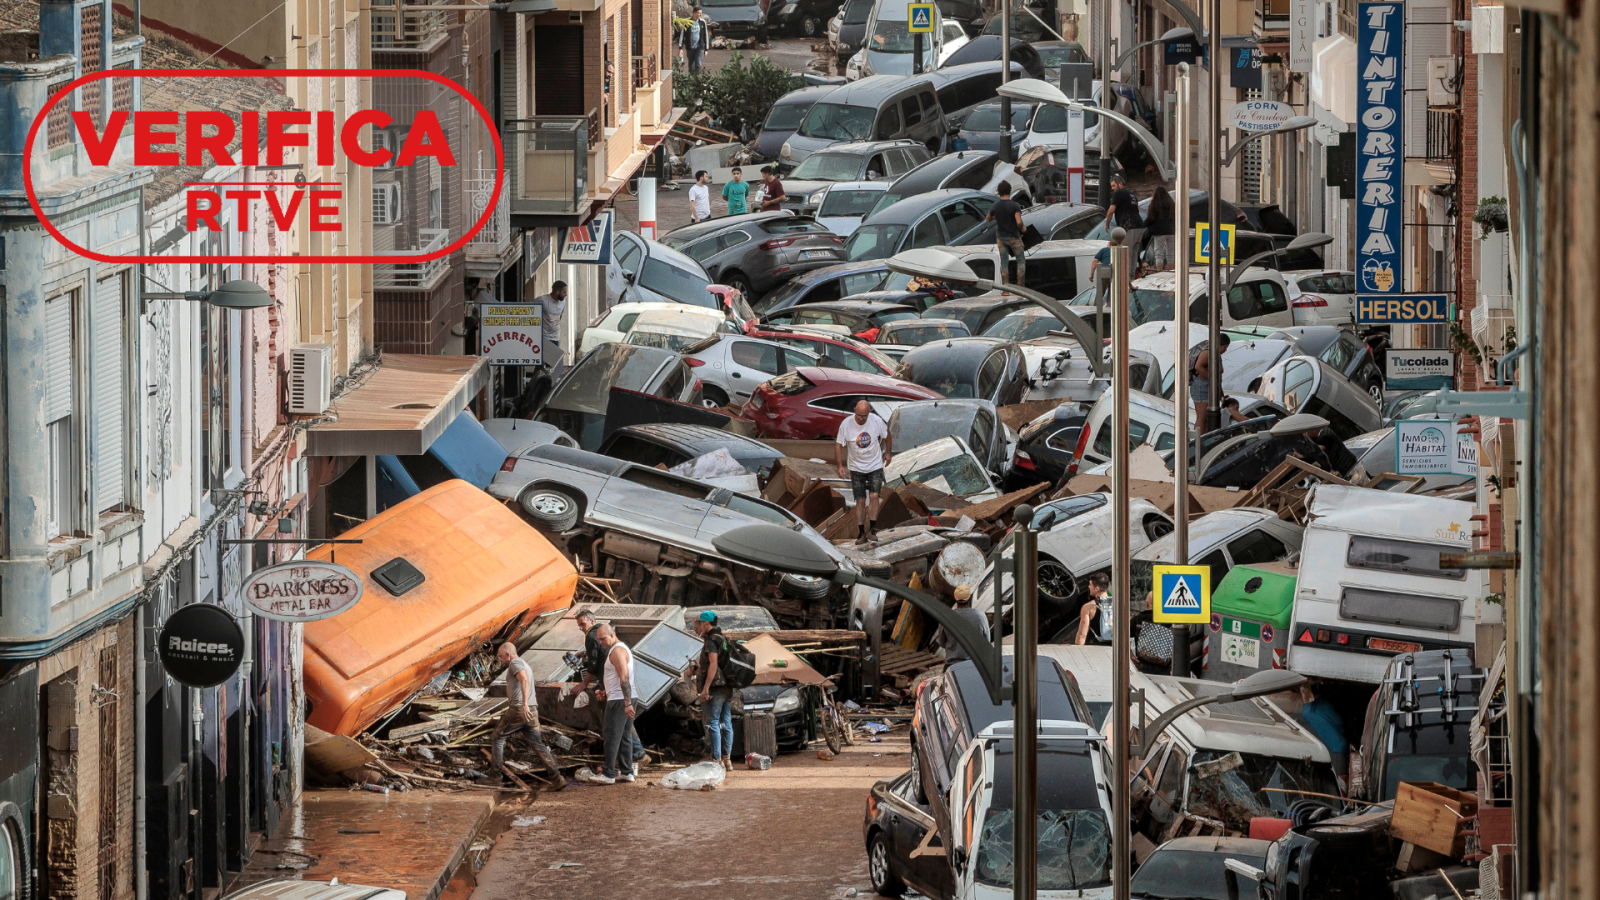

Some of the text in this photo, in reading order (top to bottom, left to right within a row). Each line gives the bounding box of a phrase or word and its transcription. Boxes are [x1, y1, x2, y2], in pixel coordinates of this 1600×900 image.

[1247, 102, 1278, 111] FORN
[1234, 110, 1247, 120] La
[1238, 120, 1283, 131] PASTISSERI
[1361, 5, 1397, 255] TINTORERIA
[567, 243, 596, 251] FIATC
[488, 306, 508, 316] POLLOS
[530, 306, 535, 316] Y
[1359, 300, 1445, 320] HERSOL
[482, 331, 541, 355] GUERRERO
[1391, 356, 1449, 367] Tucolada
[1435, 528, 1455, 539] Sun
[290, 567, 310, 579] PUB
[254, 578, 349, 599] DARKNESS
[270, 598, 331, 612] METAL BAR
[169, 635, 229, 654] Raices
[168, 652, 199, 660] cocktail
